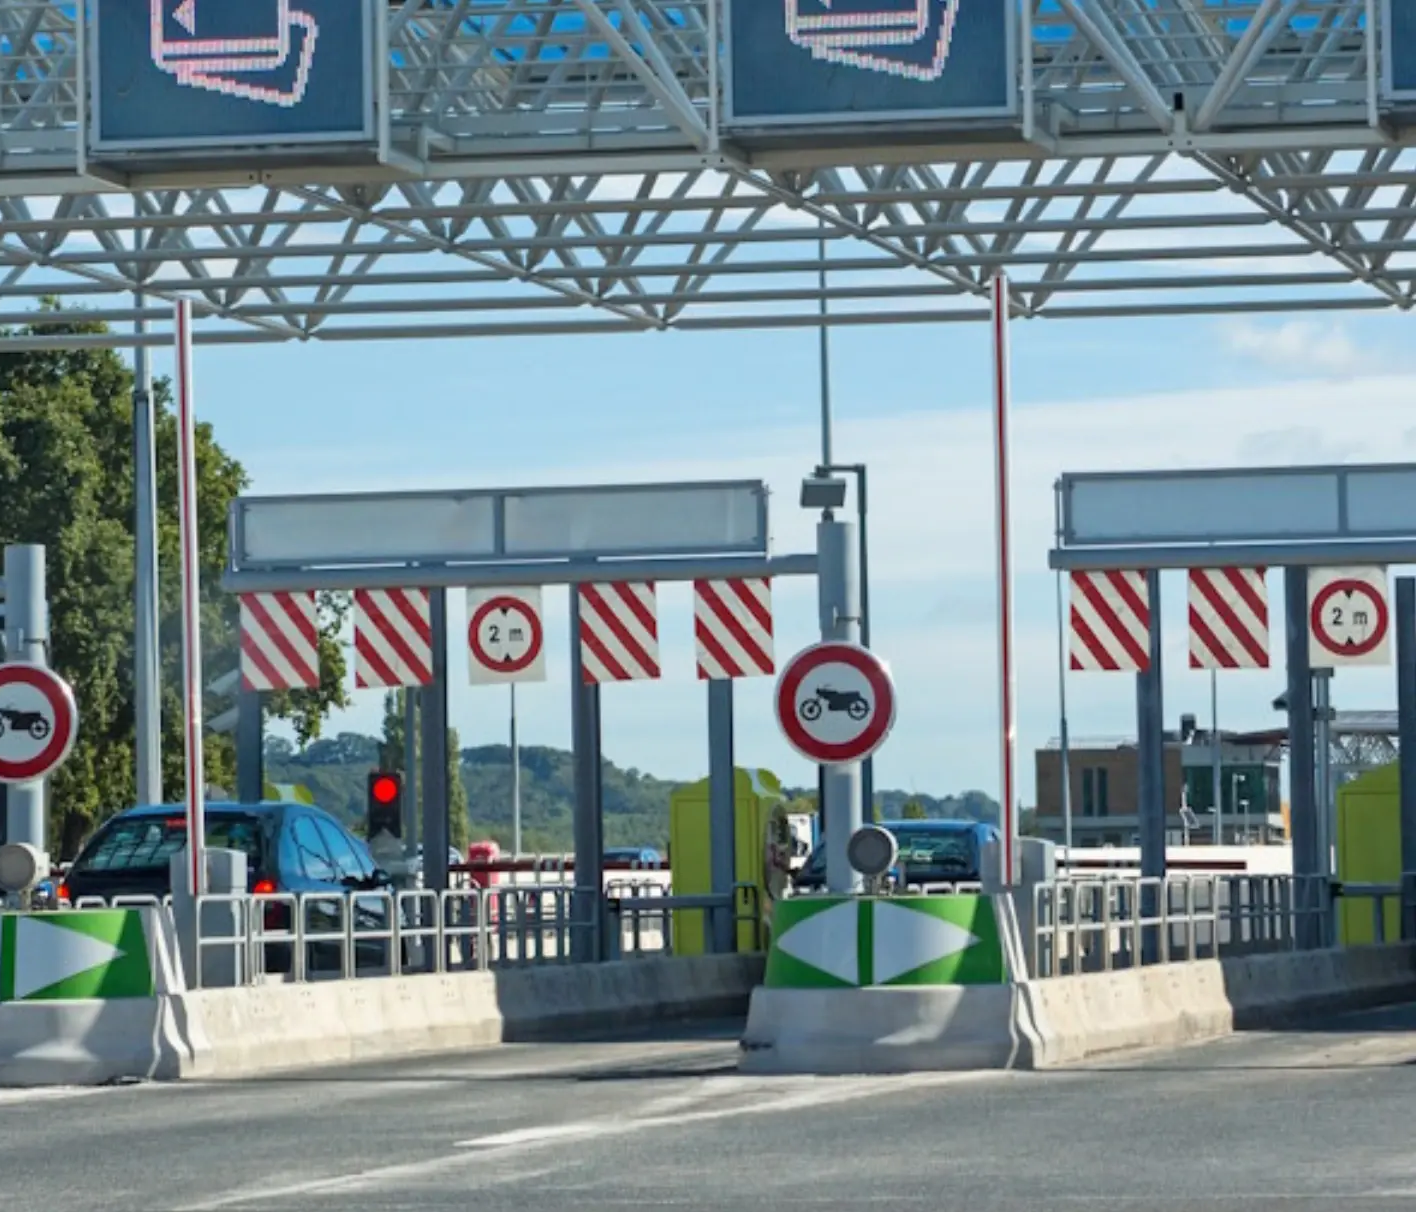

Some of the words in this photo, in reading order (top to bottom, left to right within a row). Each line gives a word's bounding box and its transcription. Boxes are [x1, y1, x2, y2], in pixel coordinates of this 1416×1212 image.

[1332, 606, 1344, 626] 2
[1352, 610, 1368, 626] m
[488, 624, 501, 643] 2
[508, 627, 524, 642] m
